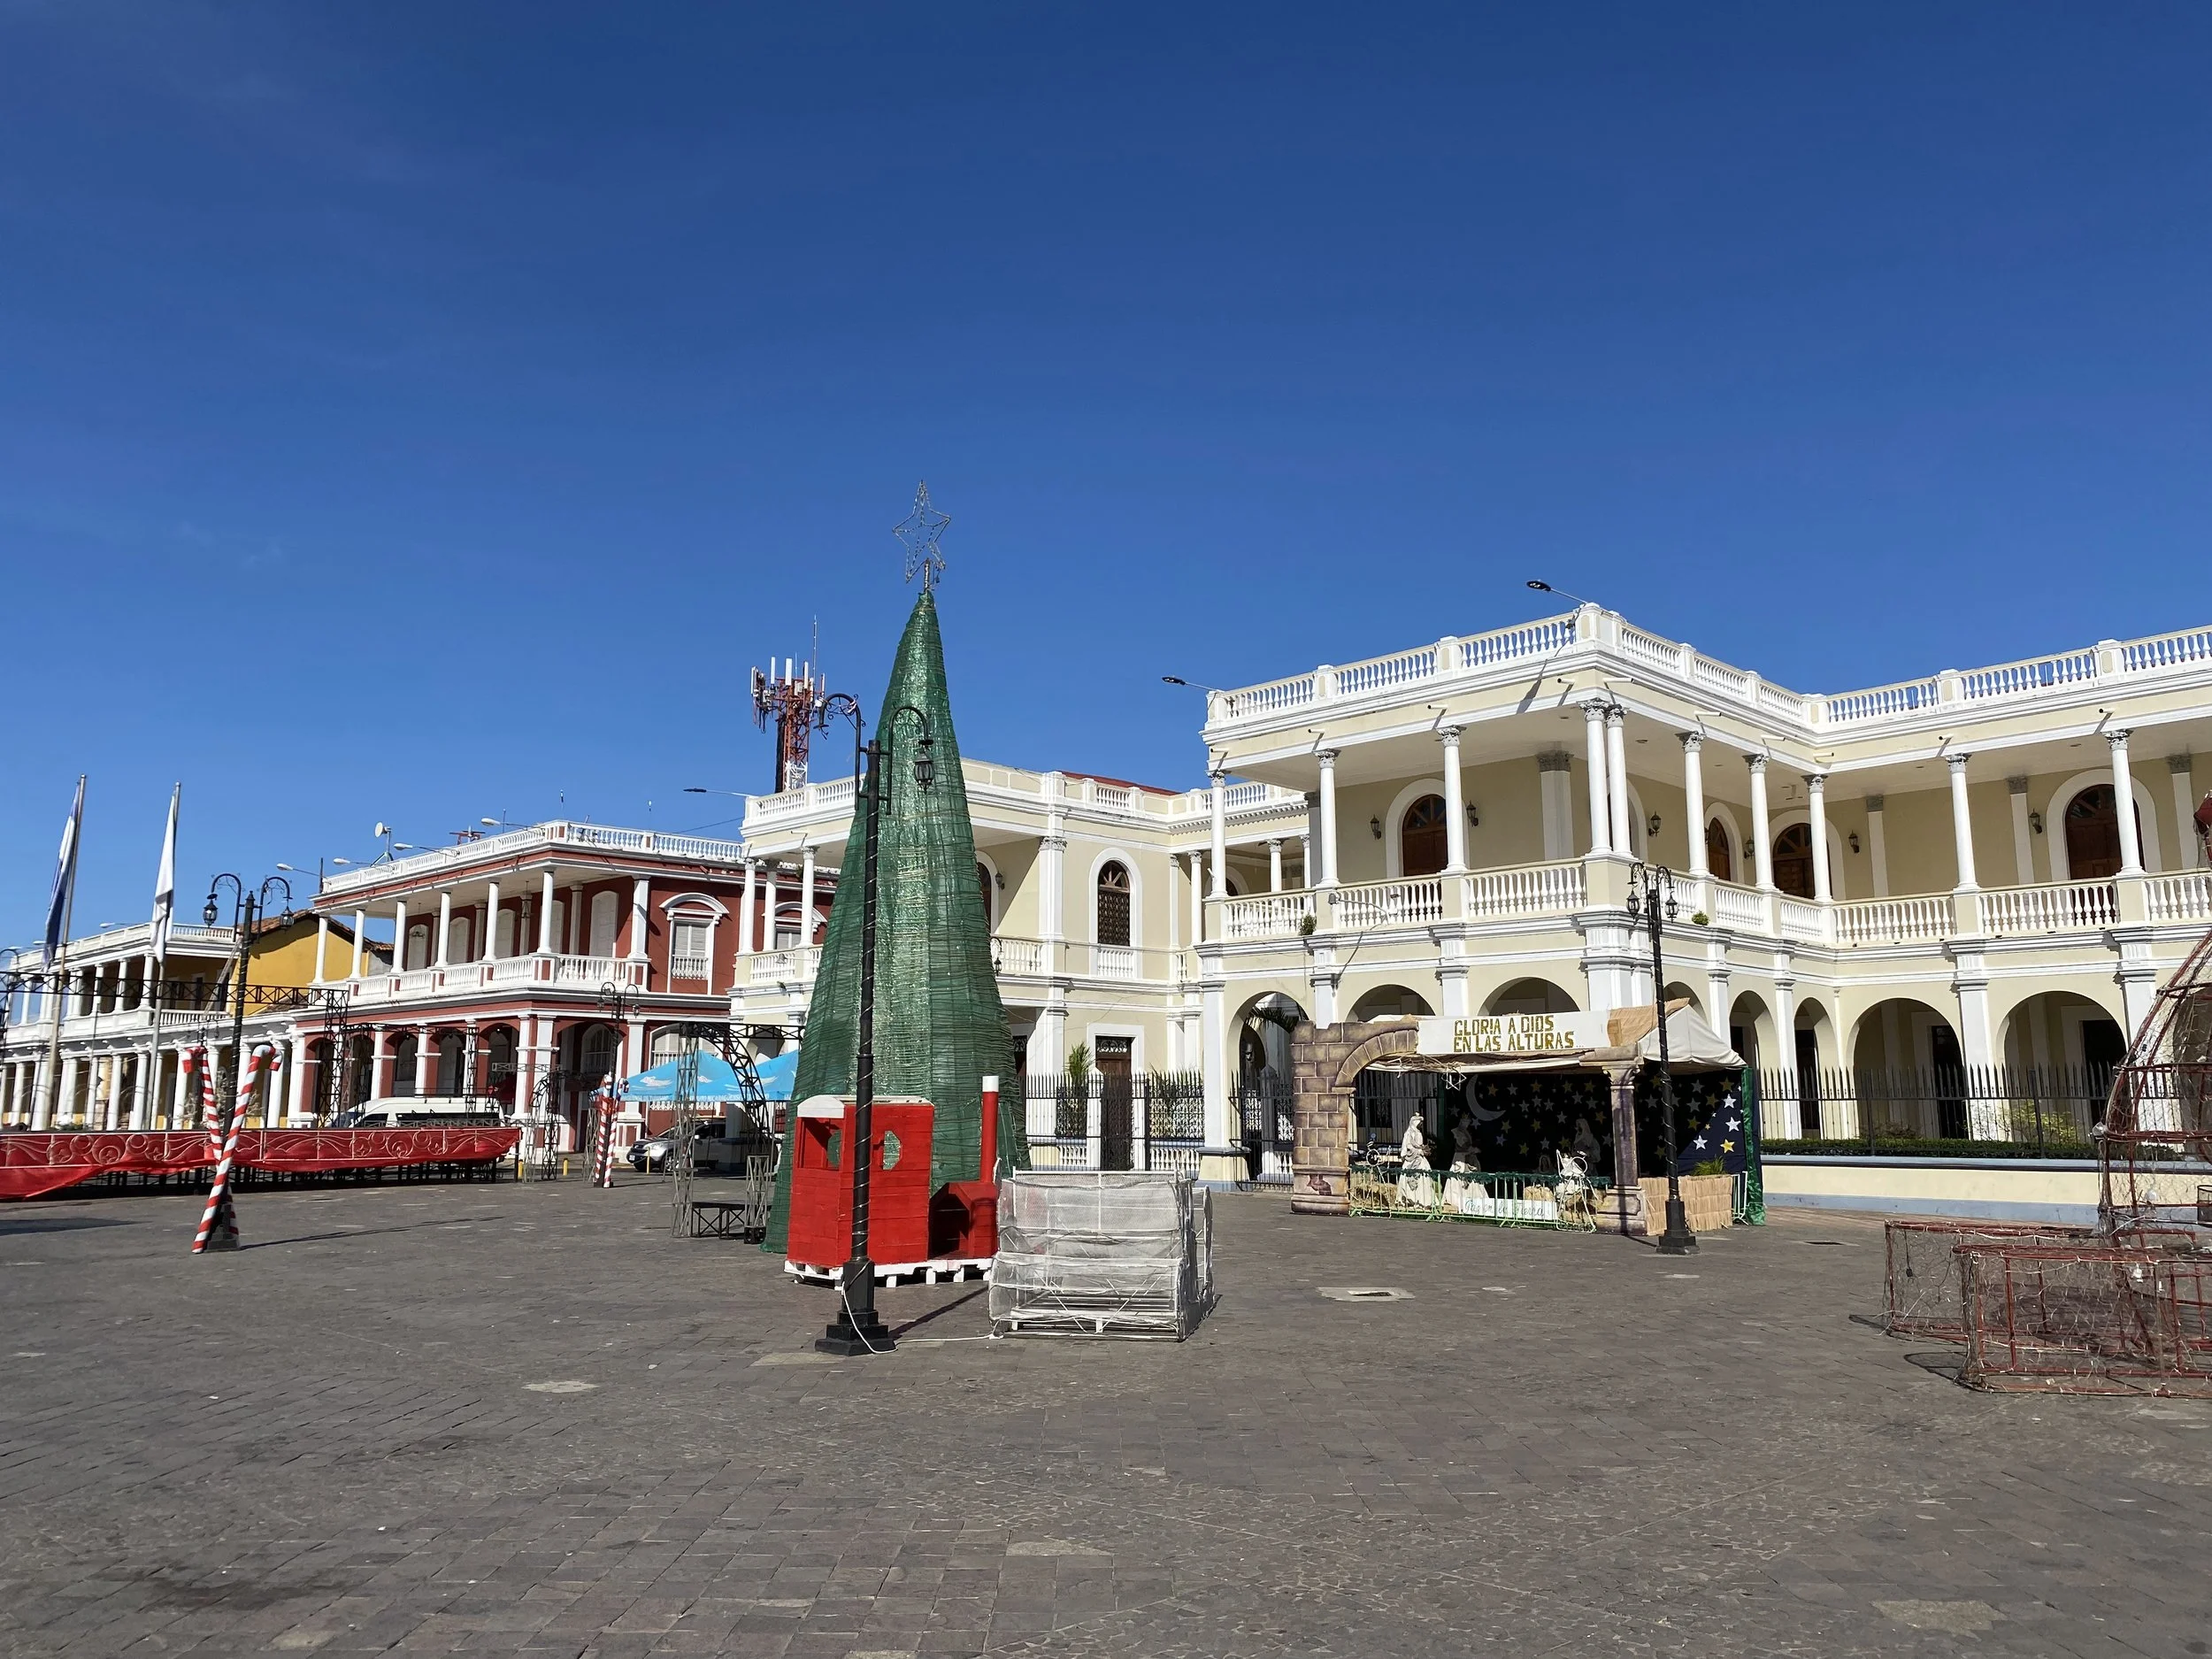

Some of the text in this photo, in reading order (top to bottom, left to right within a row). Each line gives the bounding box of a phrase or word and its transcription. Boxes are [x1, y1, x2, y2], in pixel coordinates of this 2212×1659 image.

[1455, 1015, 1554, 1035] GLORIA A DIOS
[1454, 1035, 1471, 1052] EN
[1475, 1035, 1501, 1051] LAS
